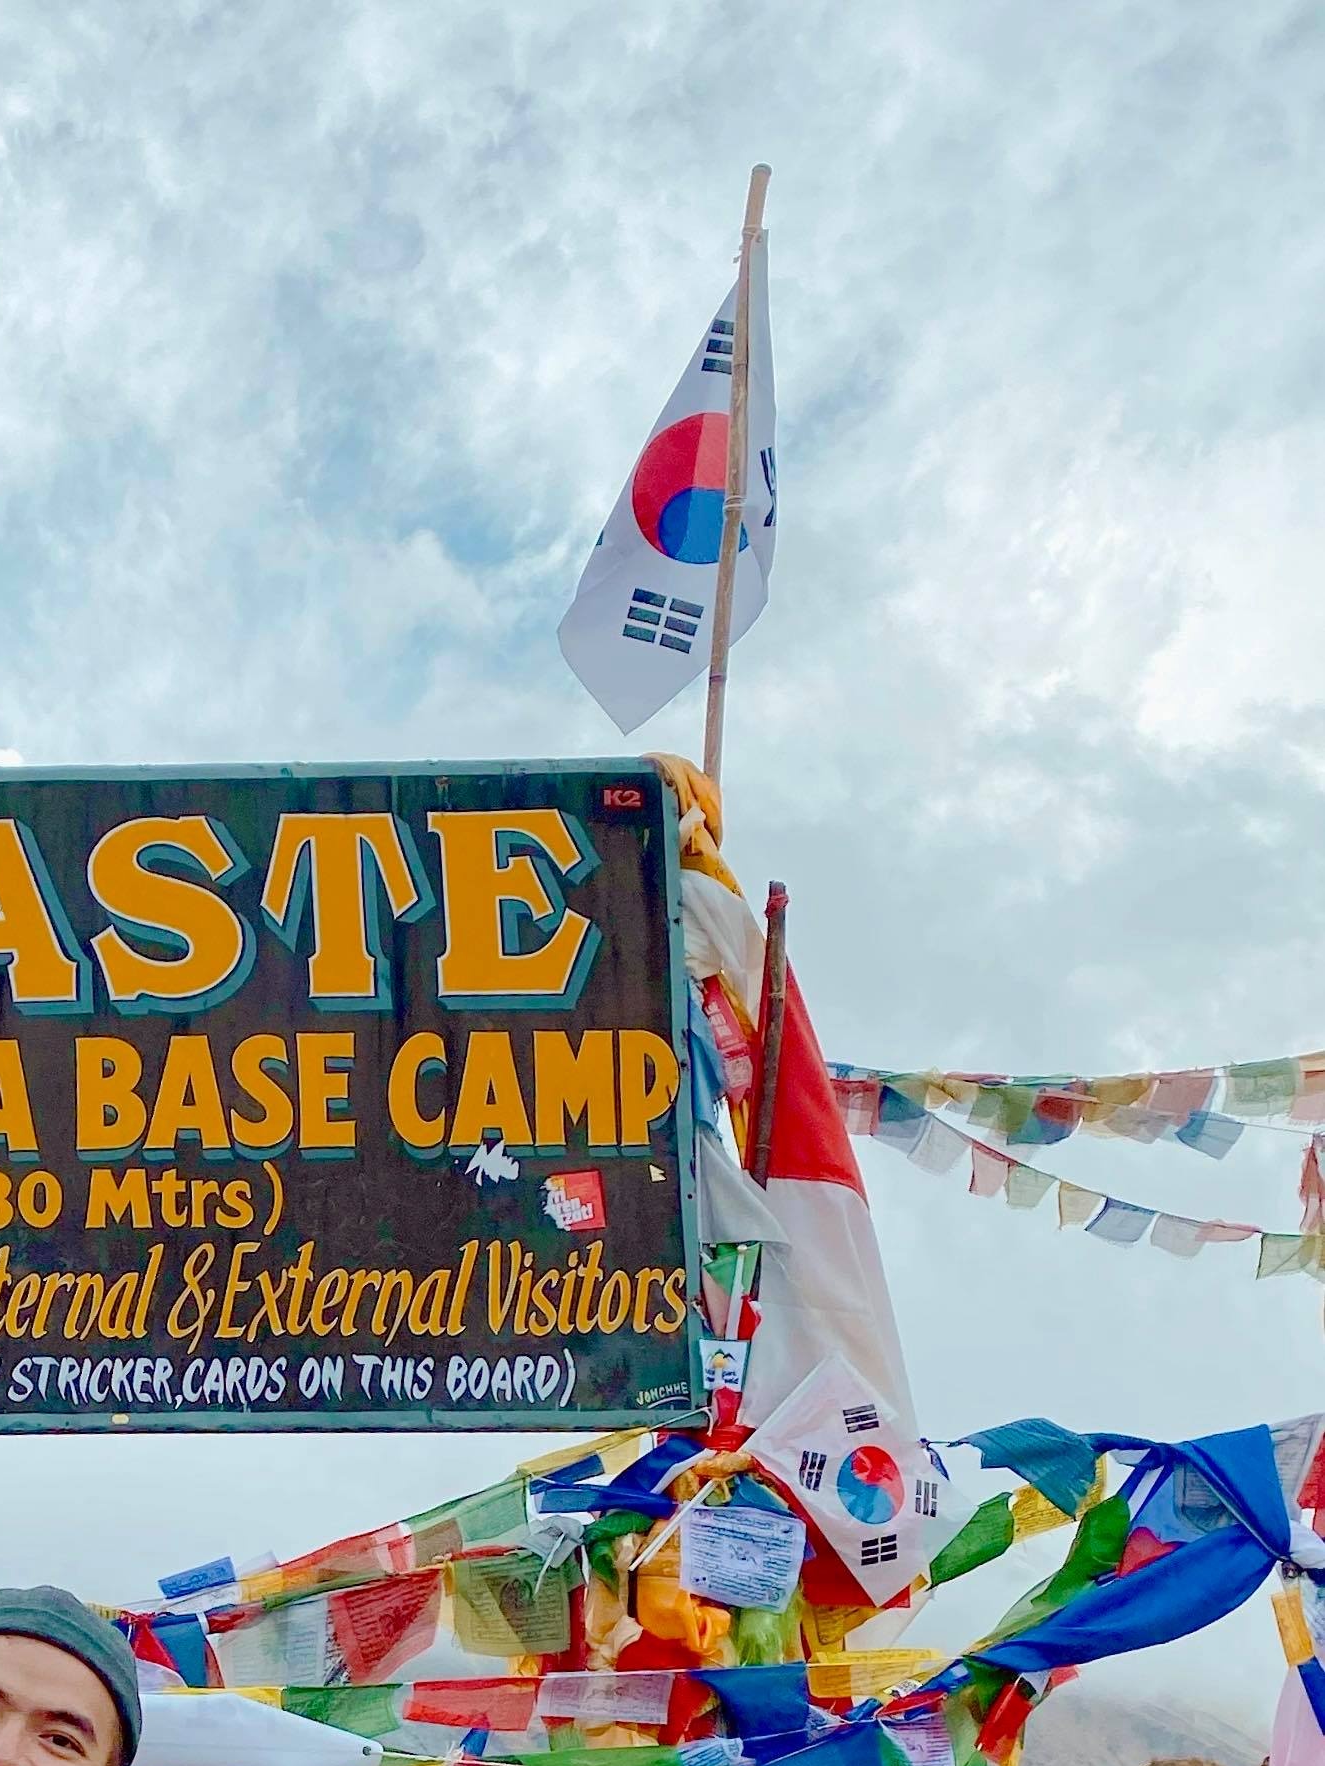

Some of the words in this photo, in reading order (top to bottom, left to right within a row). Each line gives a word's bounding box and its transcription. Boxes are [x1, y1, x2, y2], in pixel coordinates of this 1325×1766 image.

[603, 789, 642, 807] K2
[76, 1032, 357, 1156] BASE
[387, 1030, 681, 1156] CAMP
[84, 1161, 284, 1235] Mtrs)
[486, 1239, 687, 1337] Visitors
[299, 1355, 346, 1401] ON
[350, 1353, 434, 1400] THIS
[445, 1348, 577, 1407] BOARD)
